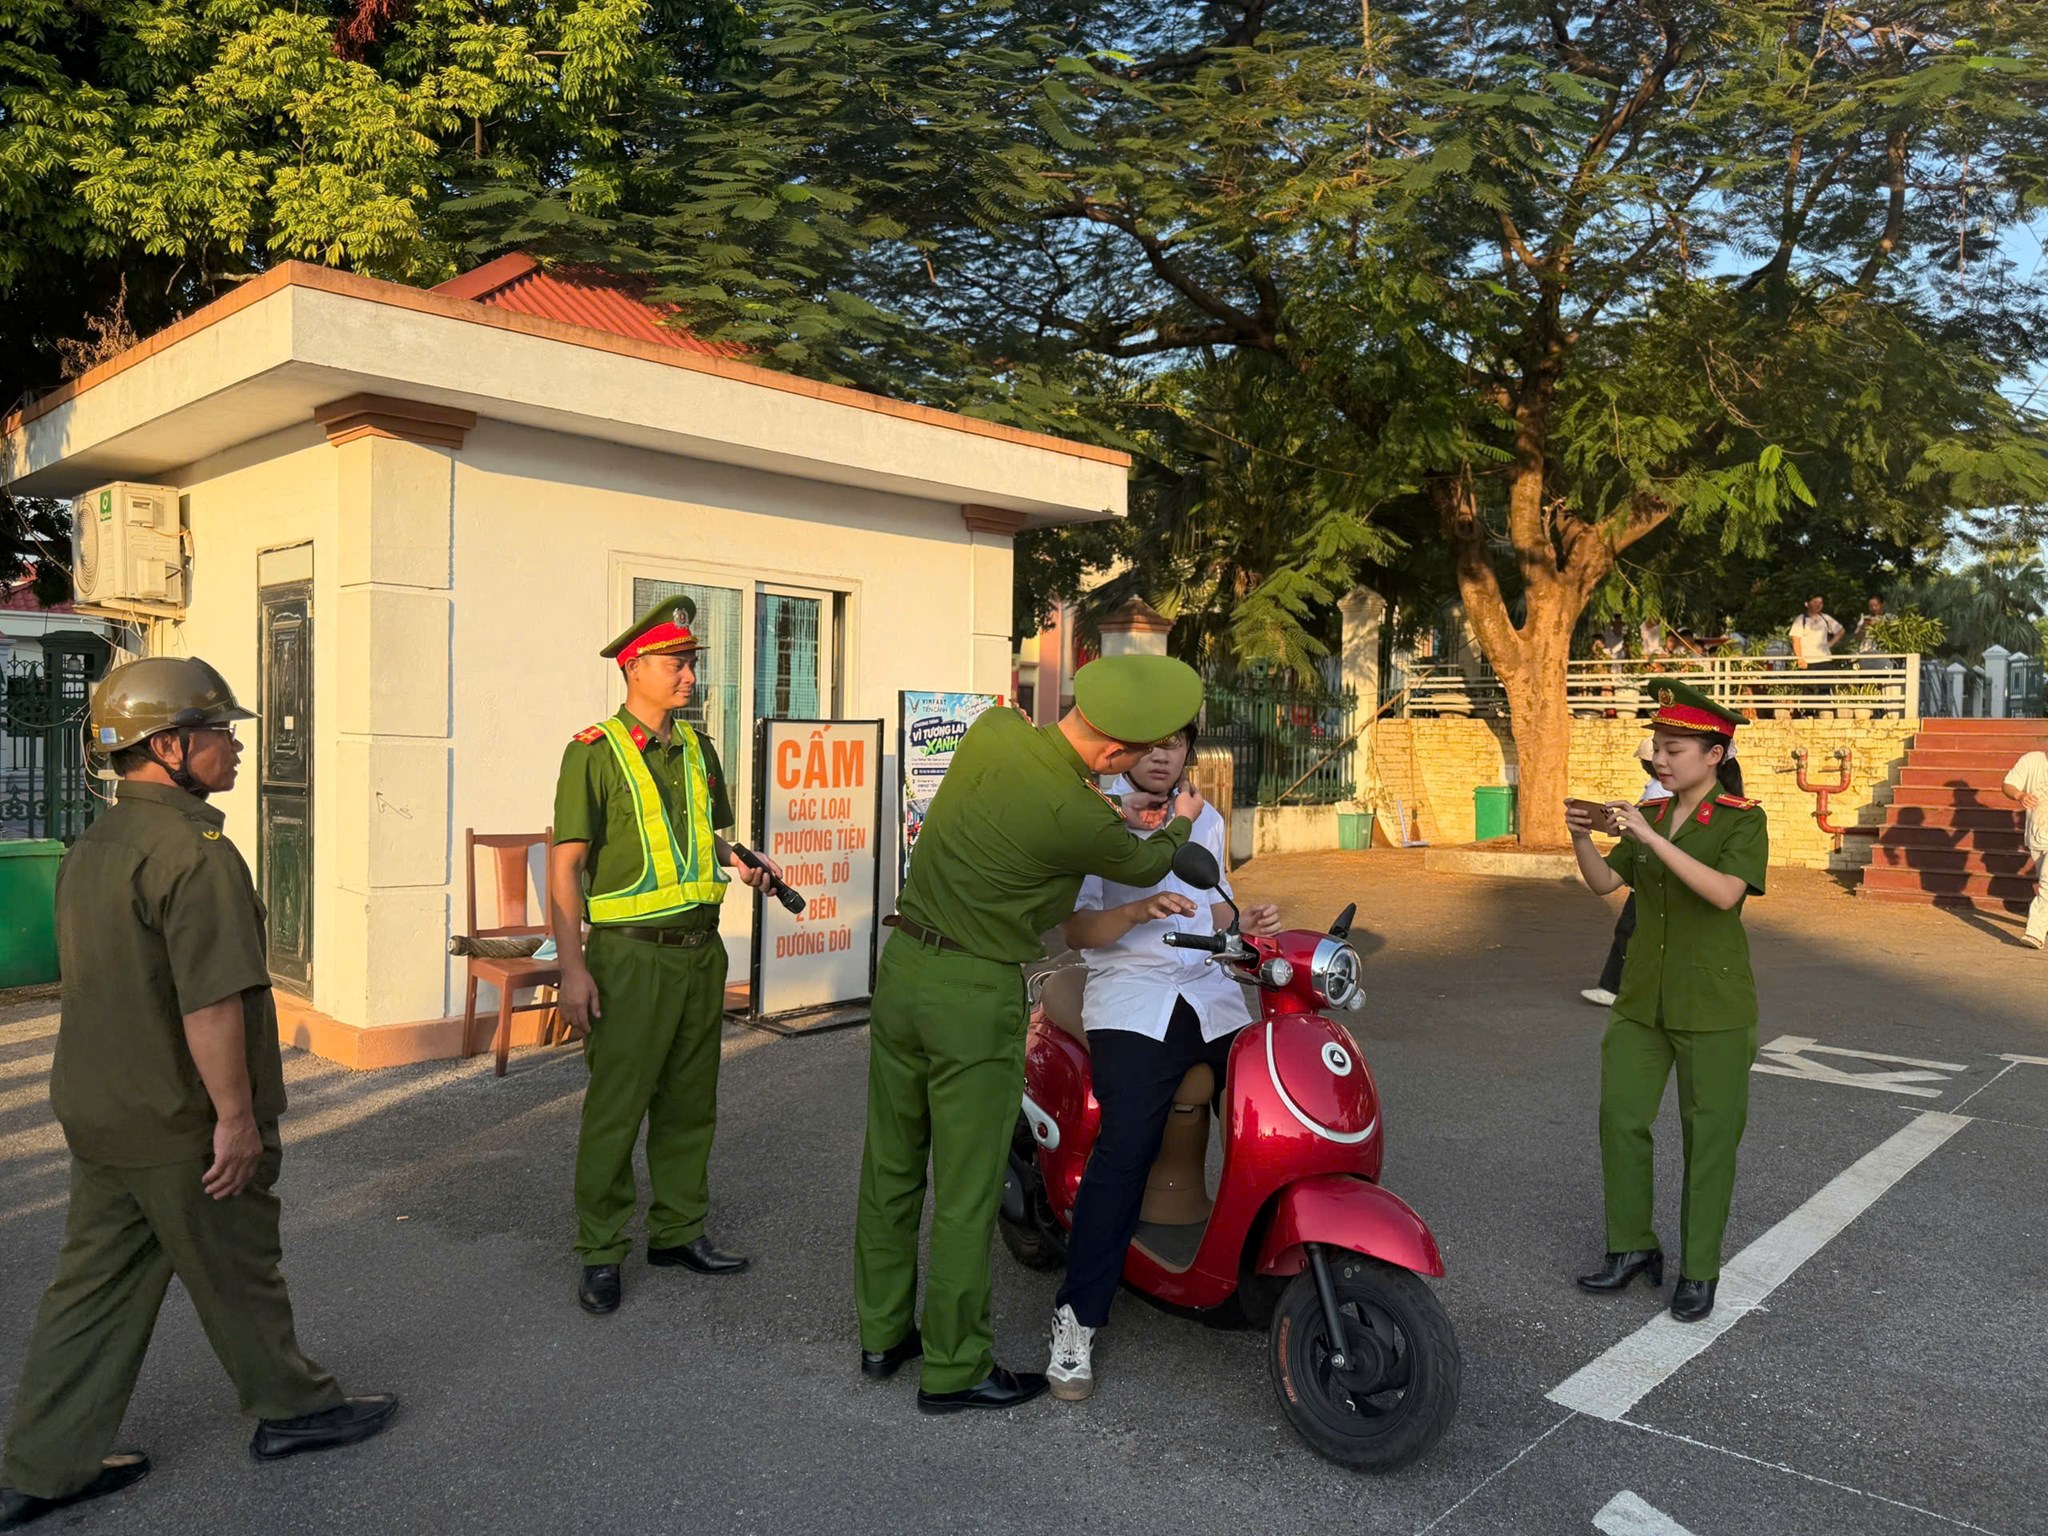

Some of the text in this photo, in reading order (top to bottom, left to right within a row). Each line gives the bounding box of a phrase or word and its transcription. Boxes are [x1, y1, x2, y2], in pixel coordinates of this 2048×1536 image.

[912, 723, 965, 742] VÌ TƯƠNG LAI
[925, 735, 959, 757] XANH
[777, 724, 864, 790] CẤM
[788, 792, 851, 824] CÁC LOẠI
[774, 823, 866, 855] PHƯƠNG TIỆN
[831, 852, 850, 883] ĐỖ
[808, 893, 837, 921] BÊN
[776, 923, 852, 959] ĐƯỜNG ĐÔI
